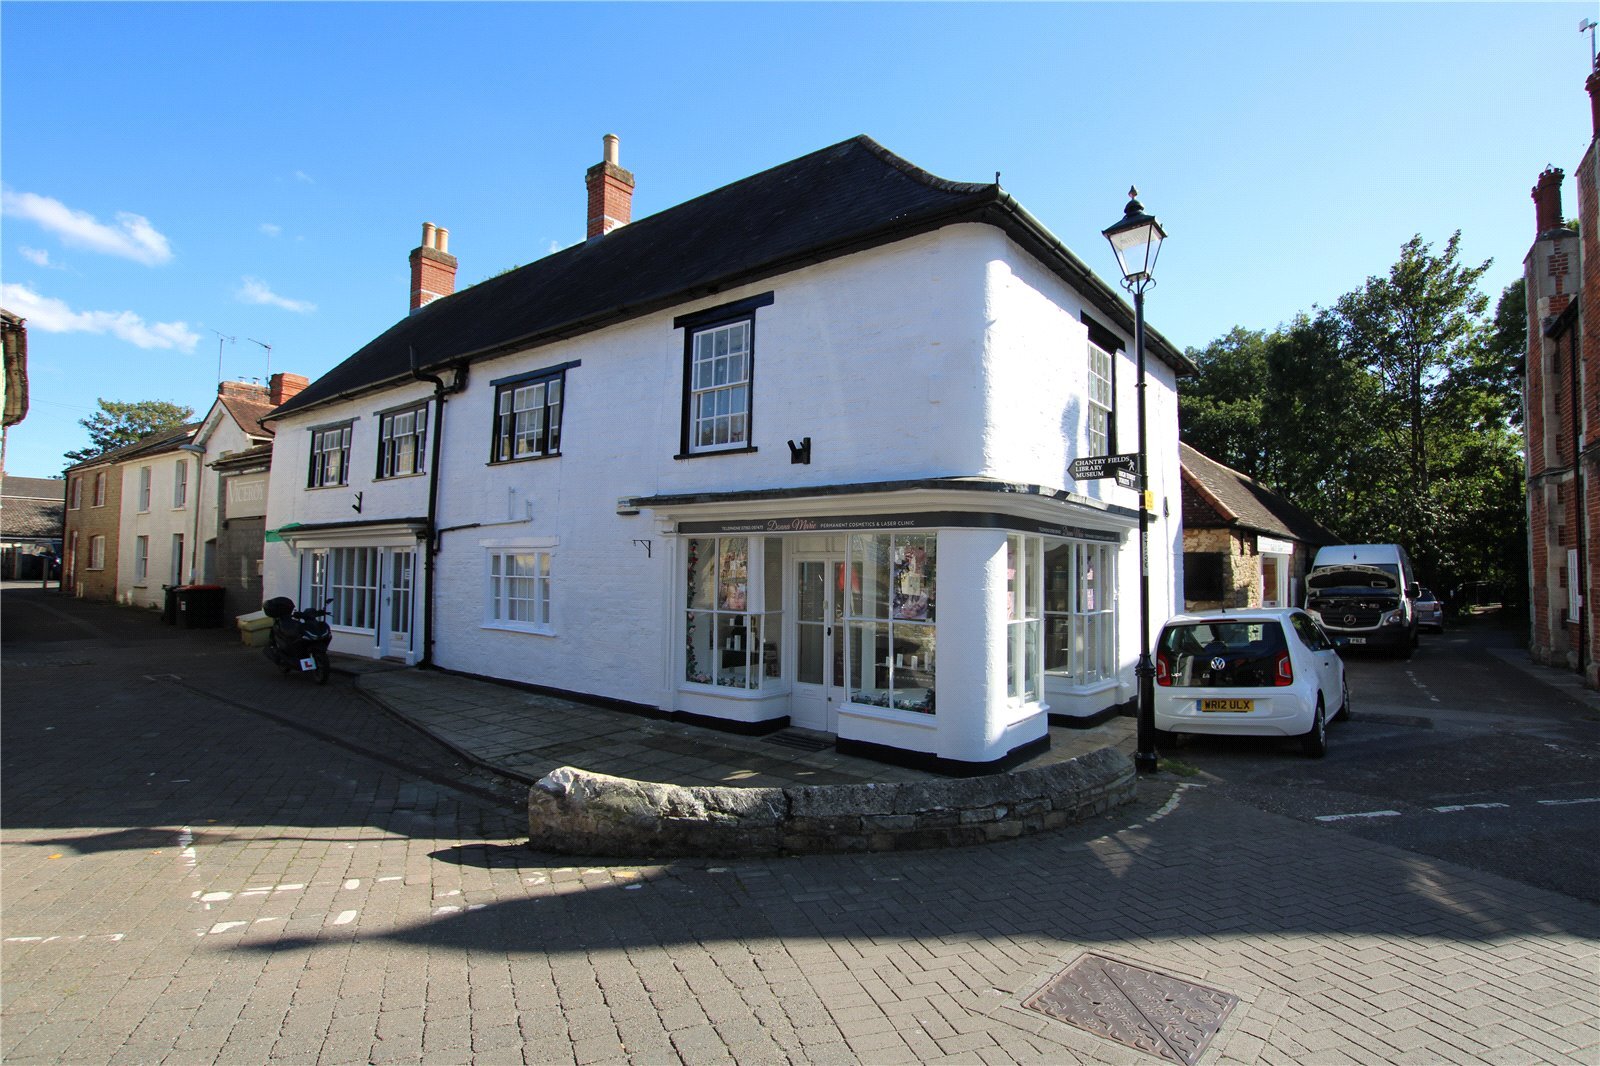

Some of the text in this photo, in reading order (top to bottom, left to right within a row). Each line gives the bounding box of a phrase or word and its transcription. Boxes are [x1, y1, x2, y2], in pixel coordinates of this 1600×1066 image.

[1075, 456, 1130, 466] CHANTRY FIELDS
[791, 519, 817, 530] Marie
[1204, 699, 1250, 710] WR12 ULX
